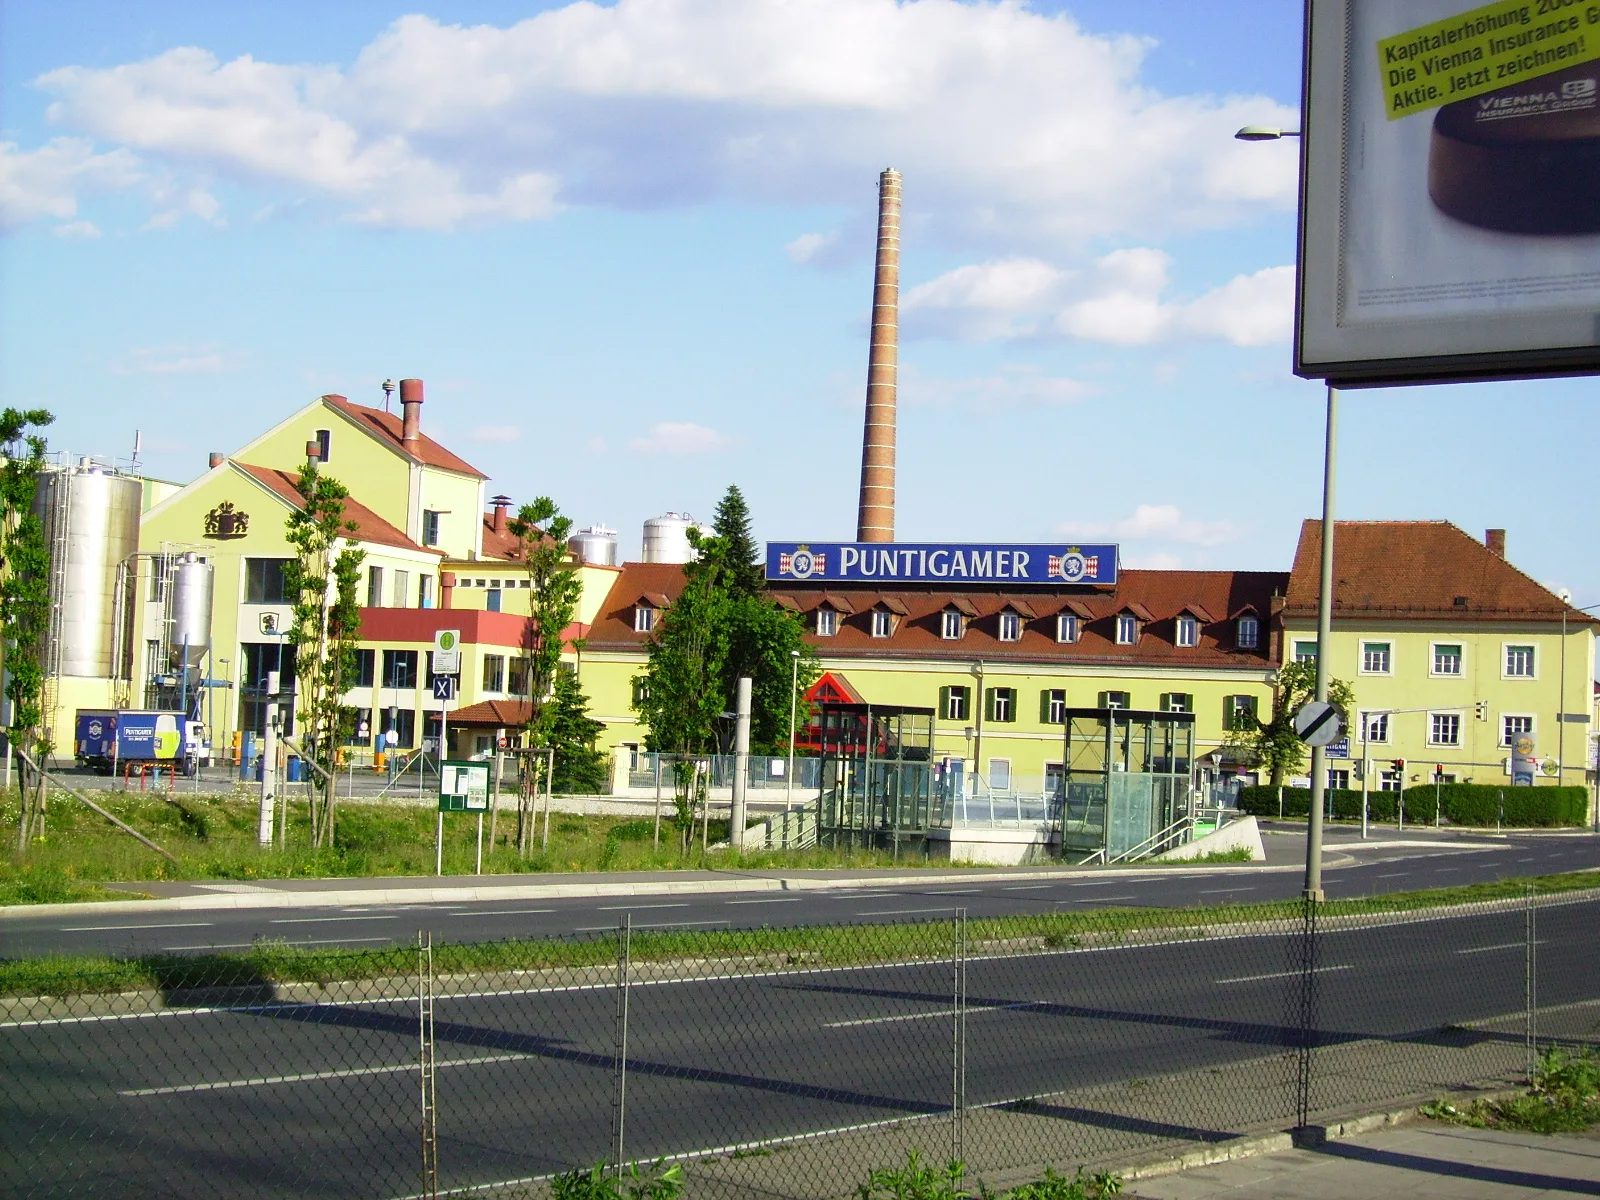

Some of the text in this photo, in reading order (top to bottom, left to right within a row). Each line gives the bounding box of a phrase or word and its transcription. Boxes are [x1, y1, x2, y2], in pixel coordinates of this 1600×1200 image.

[1385, 6, 1531, 64] Kapitalerhöhung
[1389, 66, 1417, 88] Die
[1422, 46, 1483, 77] Vienna
[1489, 15, 1580, 57] Insurance
[1393, 35, 1586, 112] Aktie. Jetzt zeichnen!
[1475, 103, 1548, 119] INSURANCE
[1479, 91, 1558, 110] VIENNA
[839, 546, 1030, 579] PUNTIGAMER
